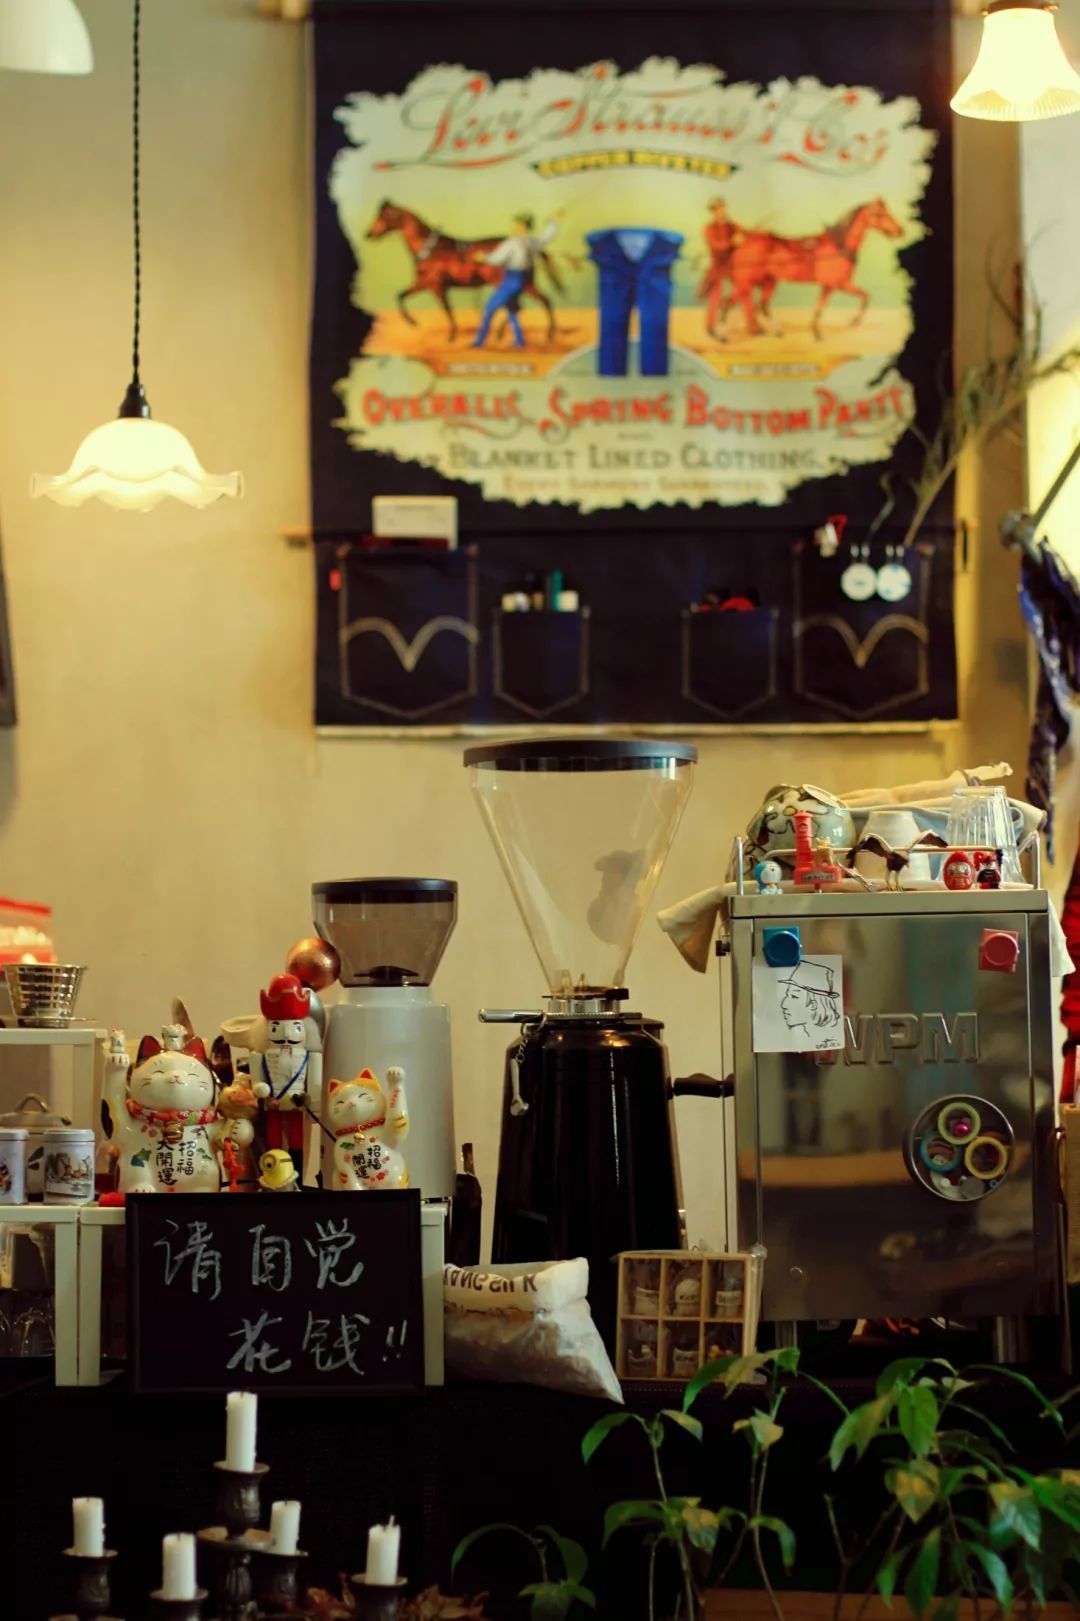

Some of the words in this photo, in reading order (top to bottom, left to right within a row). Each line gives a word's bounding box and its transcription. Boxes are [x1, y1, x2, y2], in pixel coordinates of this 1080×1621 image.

[537, 385, 672, 441] SPRING
[684, 384, 811, 435] BOTTOM
[448, 442, 576, 470] BLANKET
[588, 443, 670, 470] LINED
